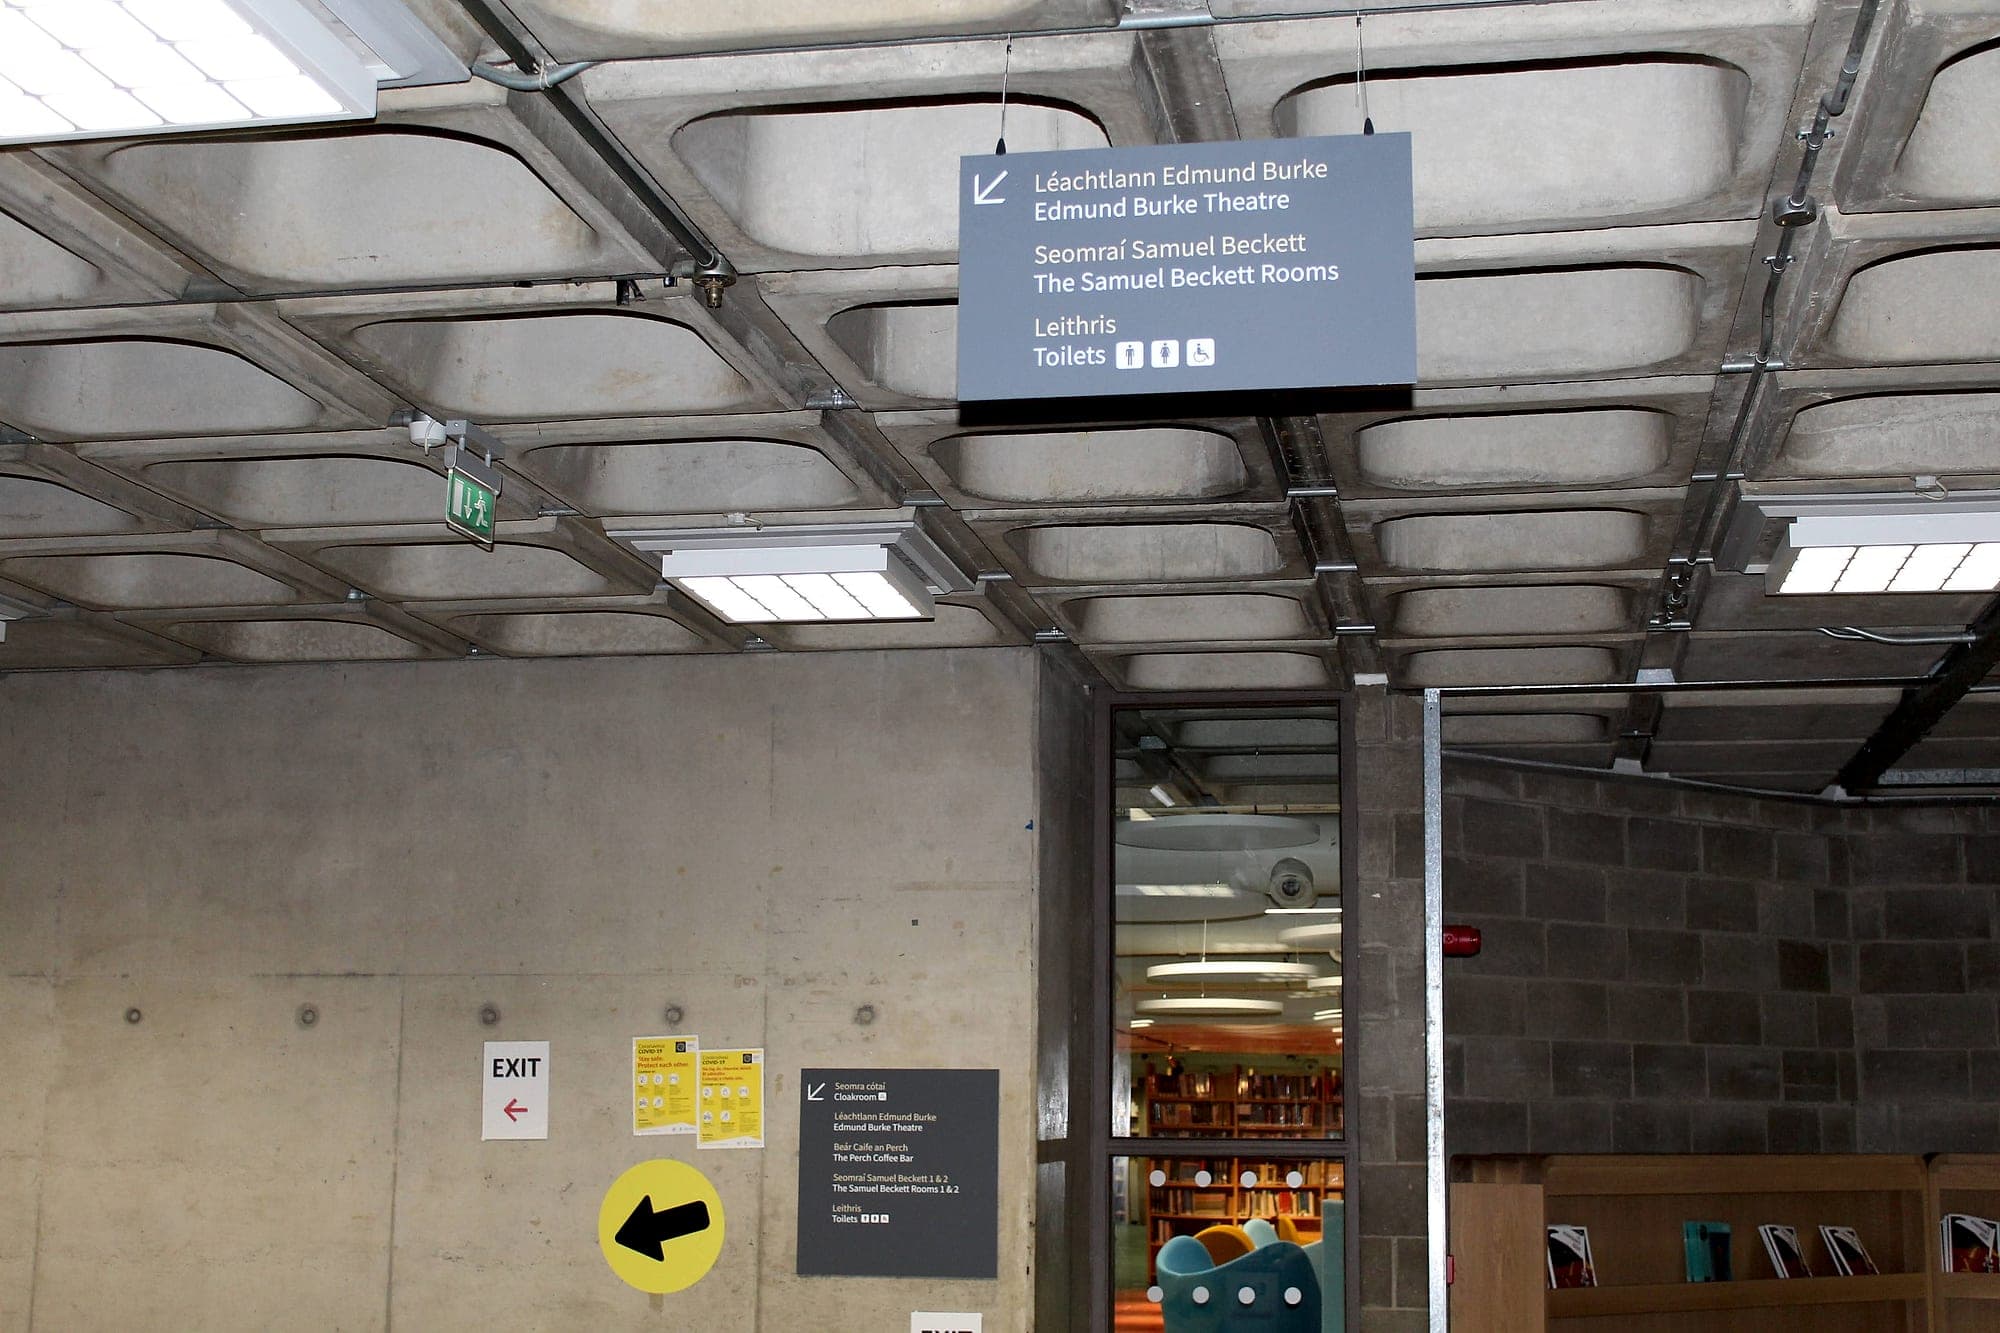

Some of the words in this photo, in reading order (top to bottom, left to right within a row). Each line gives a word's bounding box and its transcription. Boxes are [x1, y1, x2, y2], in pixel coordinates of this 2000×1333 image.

[1035, 169, 1156, 193] Léachtlann
[1163, 162, 1256, 187] Edmund
[1263, 159, 1328, 181] Burke
[1035, 197, 1126, 221] Edmund
[1134, 194, 1198, 216] Burke
[1203, 190, 1290, 212] Theatre
[1035, 239, 1127, 265] Seomraí
[1132, 236, 1215, 260] Samuel
[1222, 233, 1306, 255] Beckett
[1033, 273, 1075, 294] The
[1081, 268, 1164, 291] Samuel
[1171, 265, 1255, 287] Beckett
[1262, 261, 1339, 283] Rooms
[1035, 315, 1116, 336] Leithris
[1033, 345, 1106, 366] Toilets
[493, 1058, 541, 1077] EXIT
[835, 1082, 865, 1091] Seomra
[834, 1093, 877, 1101] Cloakroom
[834, 1112, 877, 1121] Léachtlann
[879, 1113, 912, 1121] Edmund
[914, 1113, 937, 1121] Burke
[834, 1123, 866, 1131] Edmund
[868, 1123, 891, 1131] Burke
[893, 1123, 923, 1131] Theatre
[886, 1143, 908, 1151] Perch
[833, 1154, 848, 1162] The
[850, 1154, 871, 1162] Perch
[873, 1154, 898, 1162] Coffee
[900, 1154, 913, 1162] Bar
[867, 1174, 896, 1182] Samuel
[898, 1174, 928, 1182] Beckett
[833, 1184, 847, 1192] The
[849, 1184, 878, 1192] Samuel
[880, 1185, 909, 1193] Beckett
[911, 1185, 938, 1193] Rooms
[833, 1204, 861, 1212] Leithris
[832, 1215, 858, 1223] Toilets
